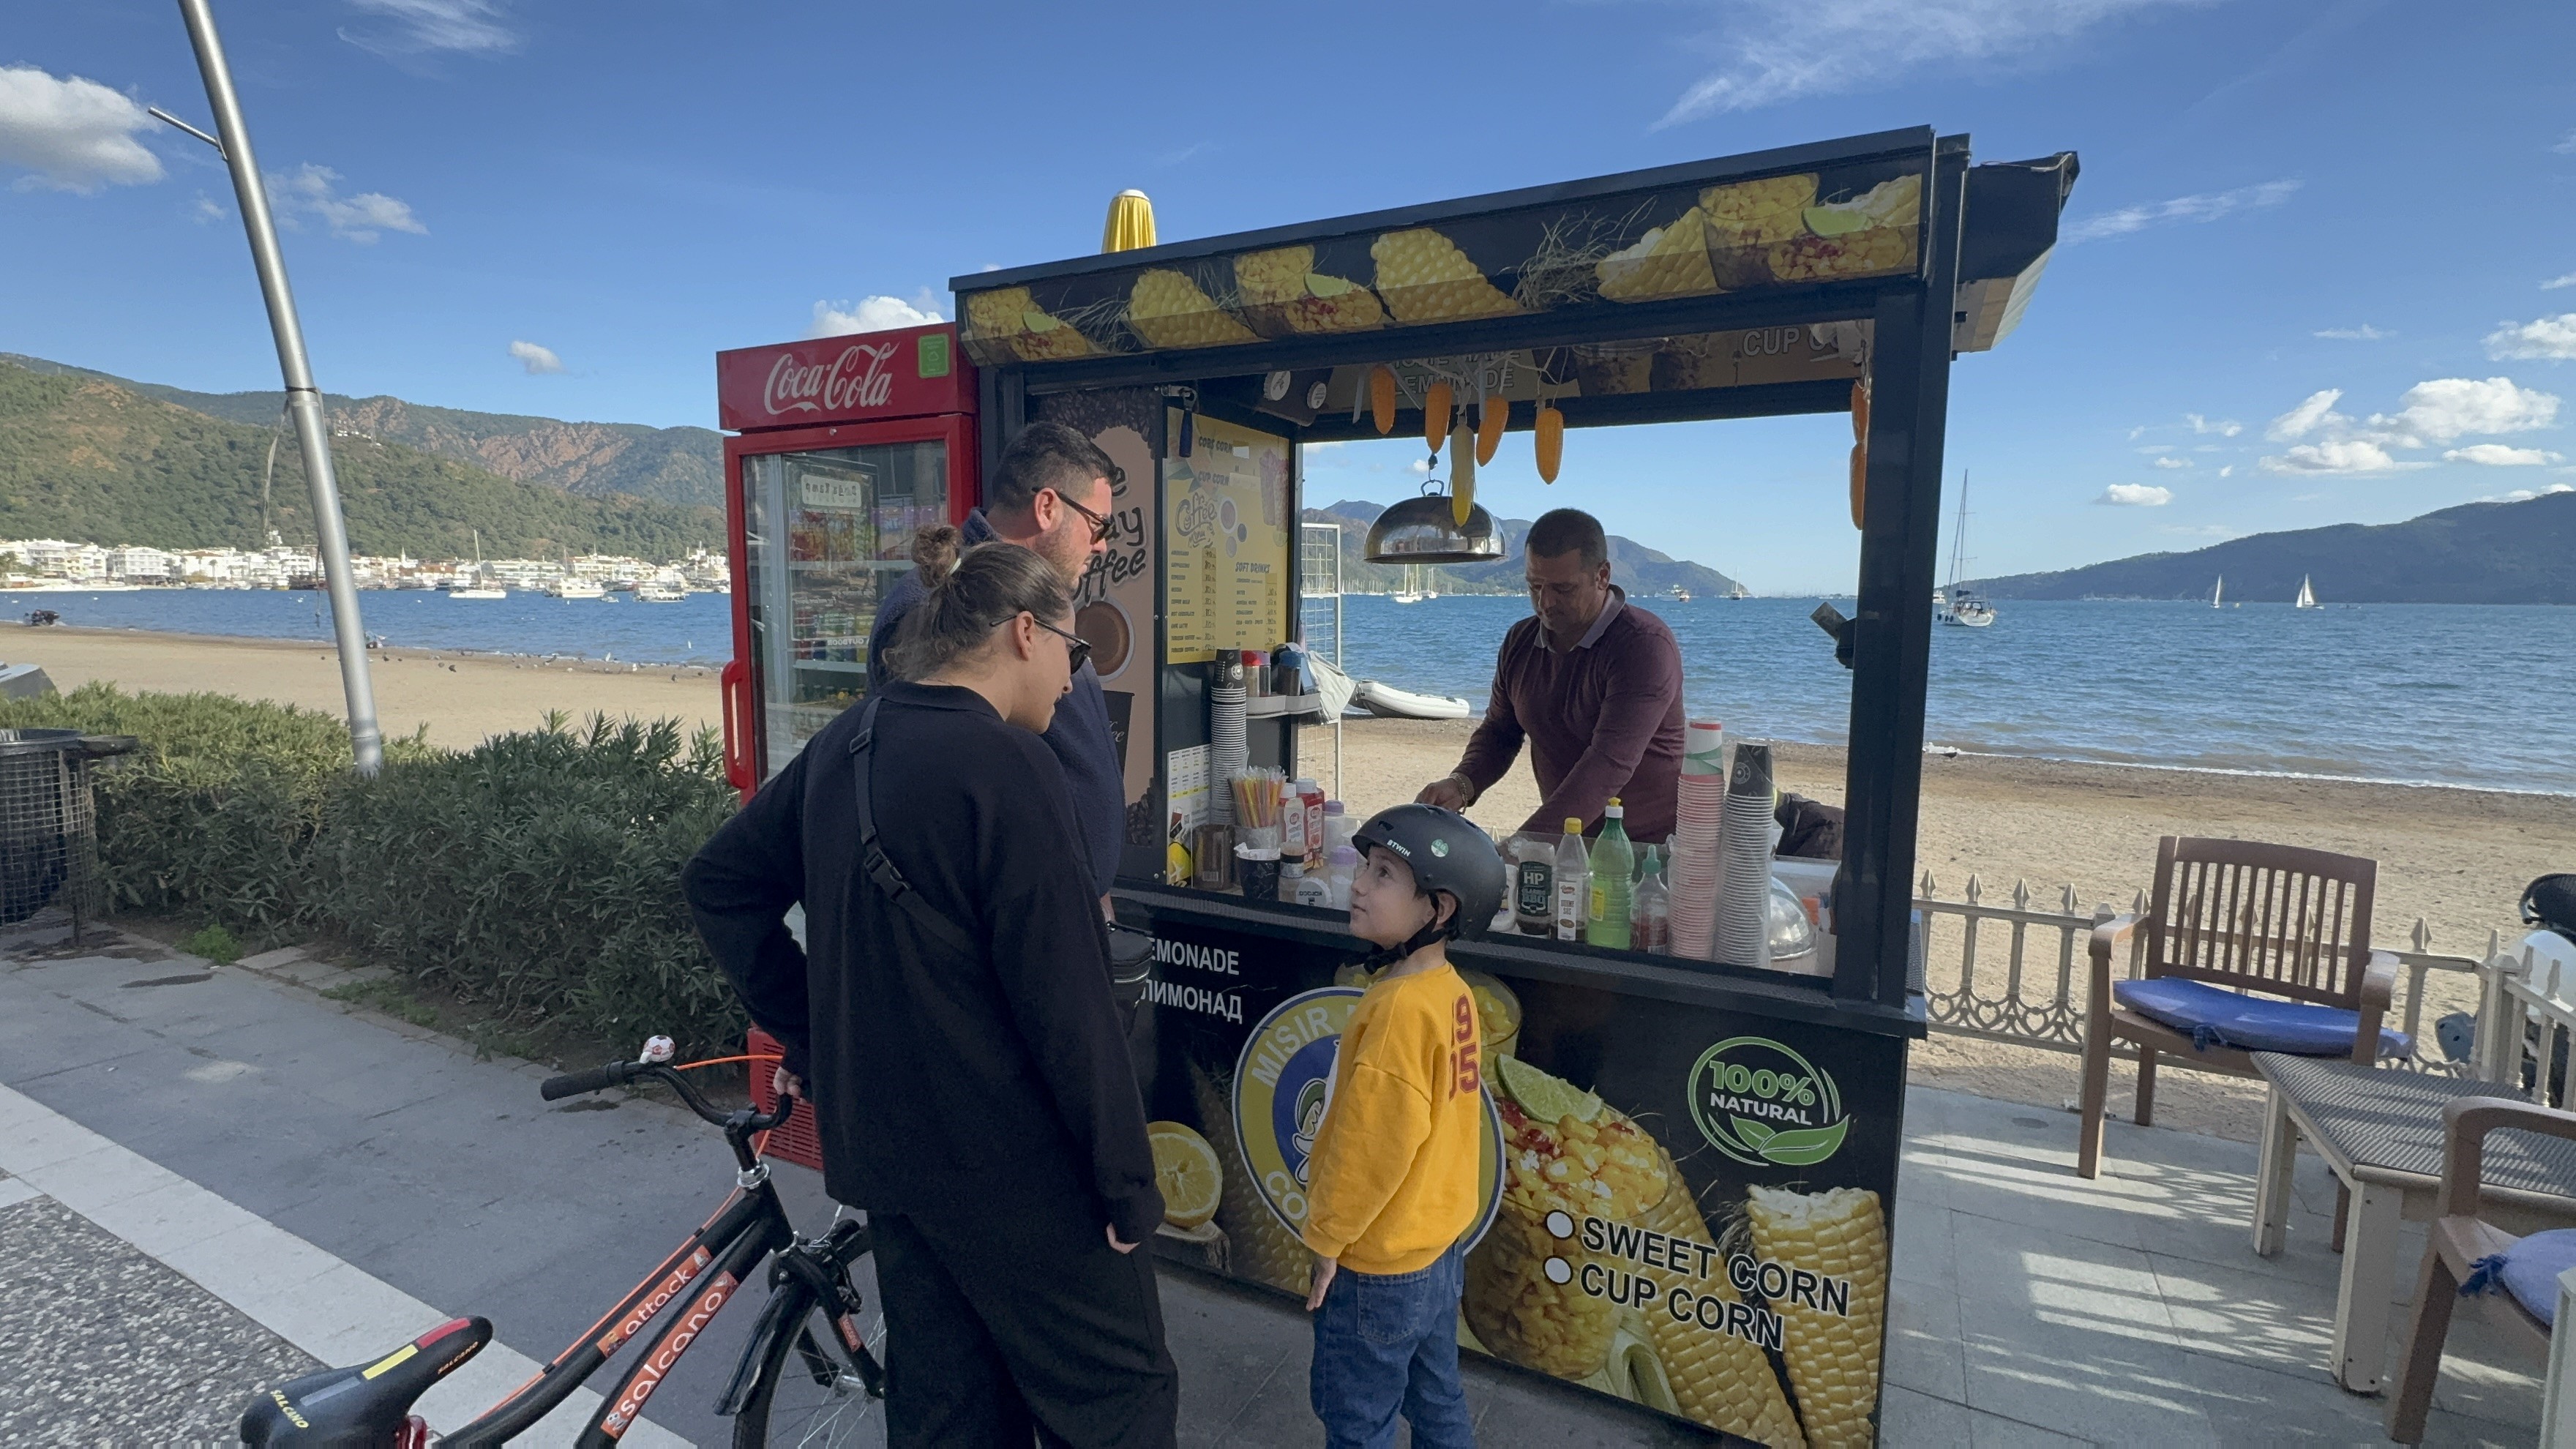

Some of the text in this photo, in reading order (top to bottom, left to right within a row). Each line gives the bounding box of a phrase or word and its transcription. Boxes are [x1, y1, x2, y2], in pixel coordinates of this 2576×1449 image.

[1743, 328, 1800, 356] CUP
[763, 342, 901, 415] Coca-Cola
[1216, 441, 1233, 453] CORN
[1197, 470, 1229, 486] CUP CORN
[1175, 492, 1217, 536] Coffee
[1235, 562, 1270, 574] SOFT DRINKS
[1387, 839, 1411, 858] BTWIN
[1524, 872, 1544, 886] HP
[1451, 993, 1473, 1047] 9
[1251, 1005, 1335, 1088] MISIR
[1709, 1060, 1816, 1107] 100%
[1710, 1092, 1813, 1126] NATURAL
[1581, 1216, 1849, 1317] SWEET CORN
[626, 1268, 691, 1335] attack
[1579, 1263, 1783, 1352] CUP CORN
[621, 1292, 722, 1416] salcano
